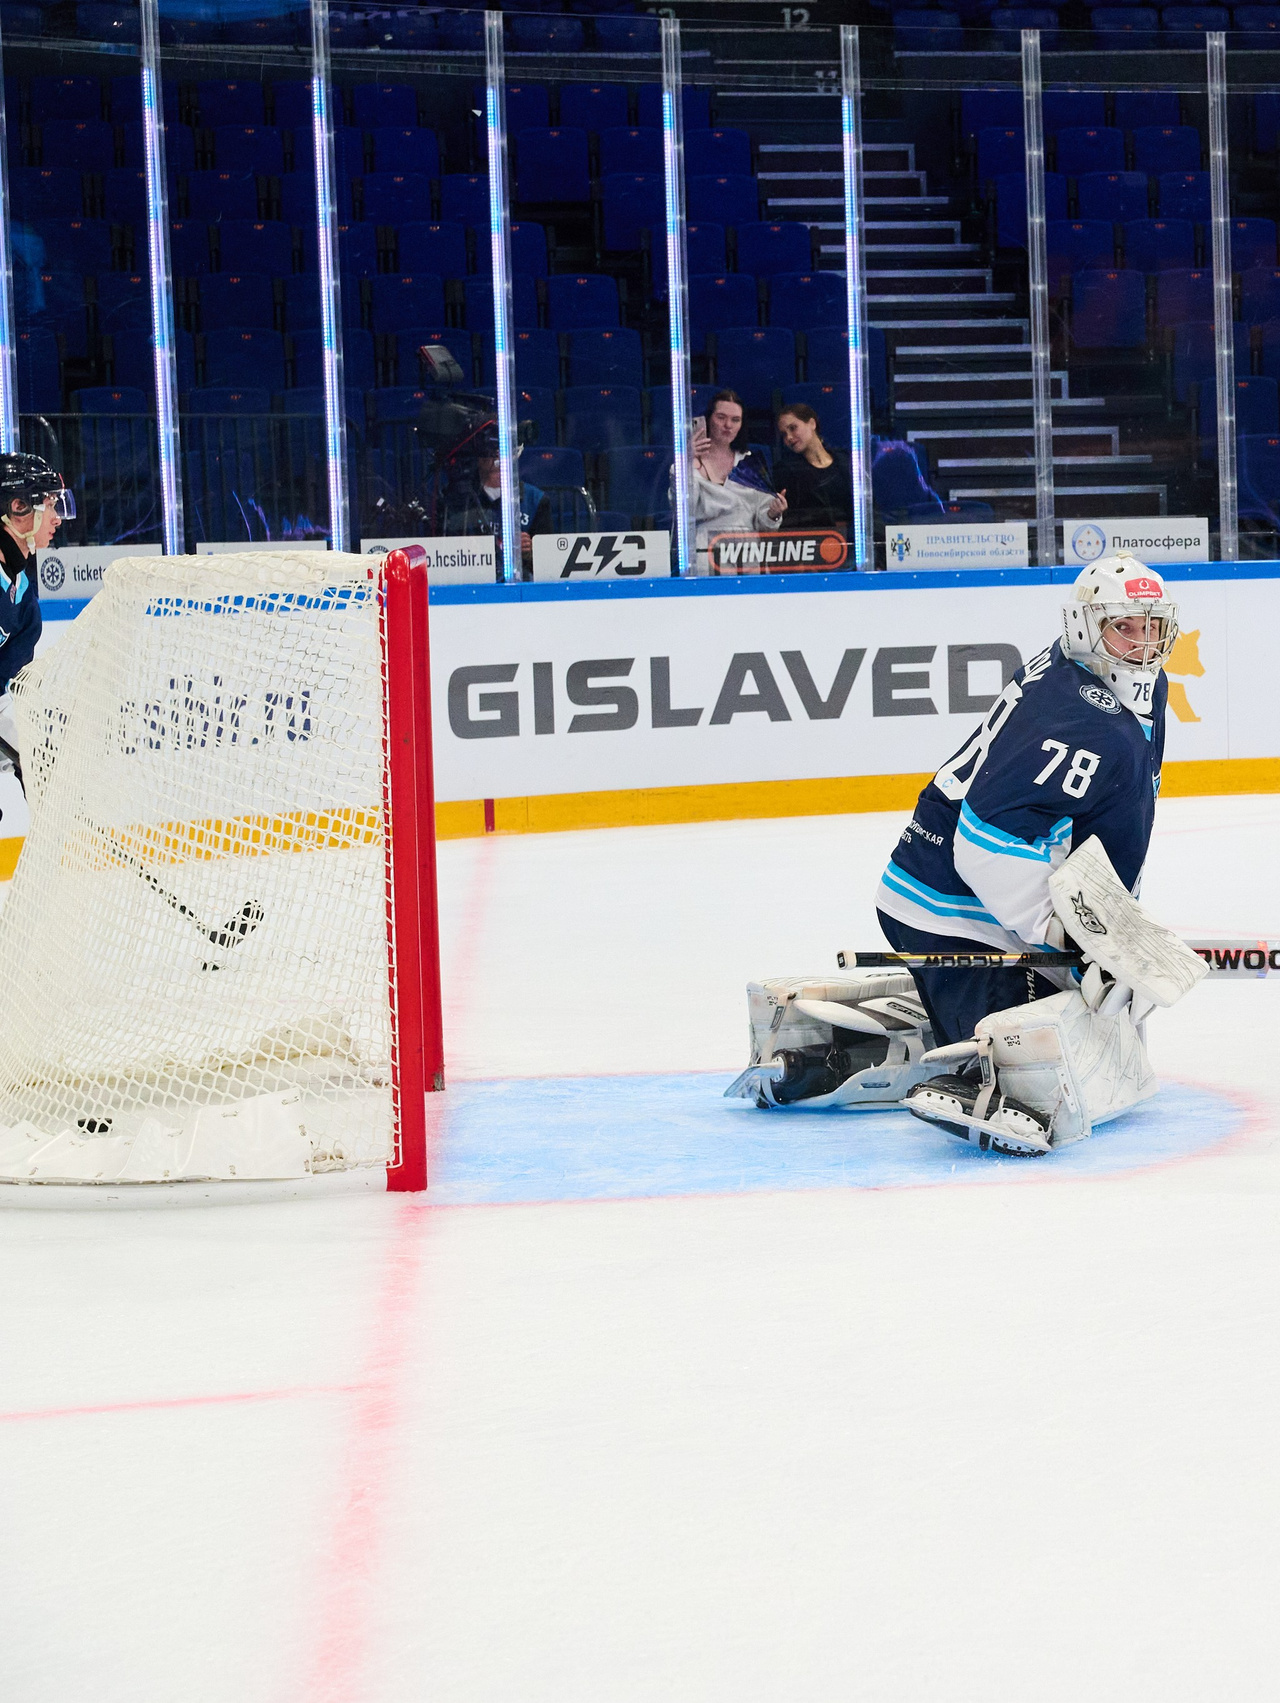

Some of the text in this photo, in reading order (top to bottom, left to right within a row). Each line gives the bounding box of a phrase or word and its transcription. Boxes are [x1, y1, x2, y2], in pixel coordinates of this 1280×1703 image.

[781, 8, 811, 31] 12
[926, 534, 1015, 545] ПРАВИТЕЛЬСТВО
[1112, 536, 1201, 550] Платосфера
[718, 540, 816, 564] WINLINE
[917, 548, 987, 559] Новосибирской
[73, 564, 106, 581] ticket
[447, 643, 1025, 740] GISLAVED
[1132, 683, 1151, 702] 78
[1033, 738, 1102, 799] 78
